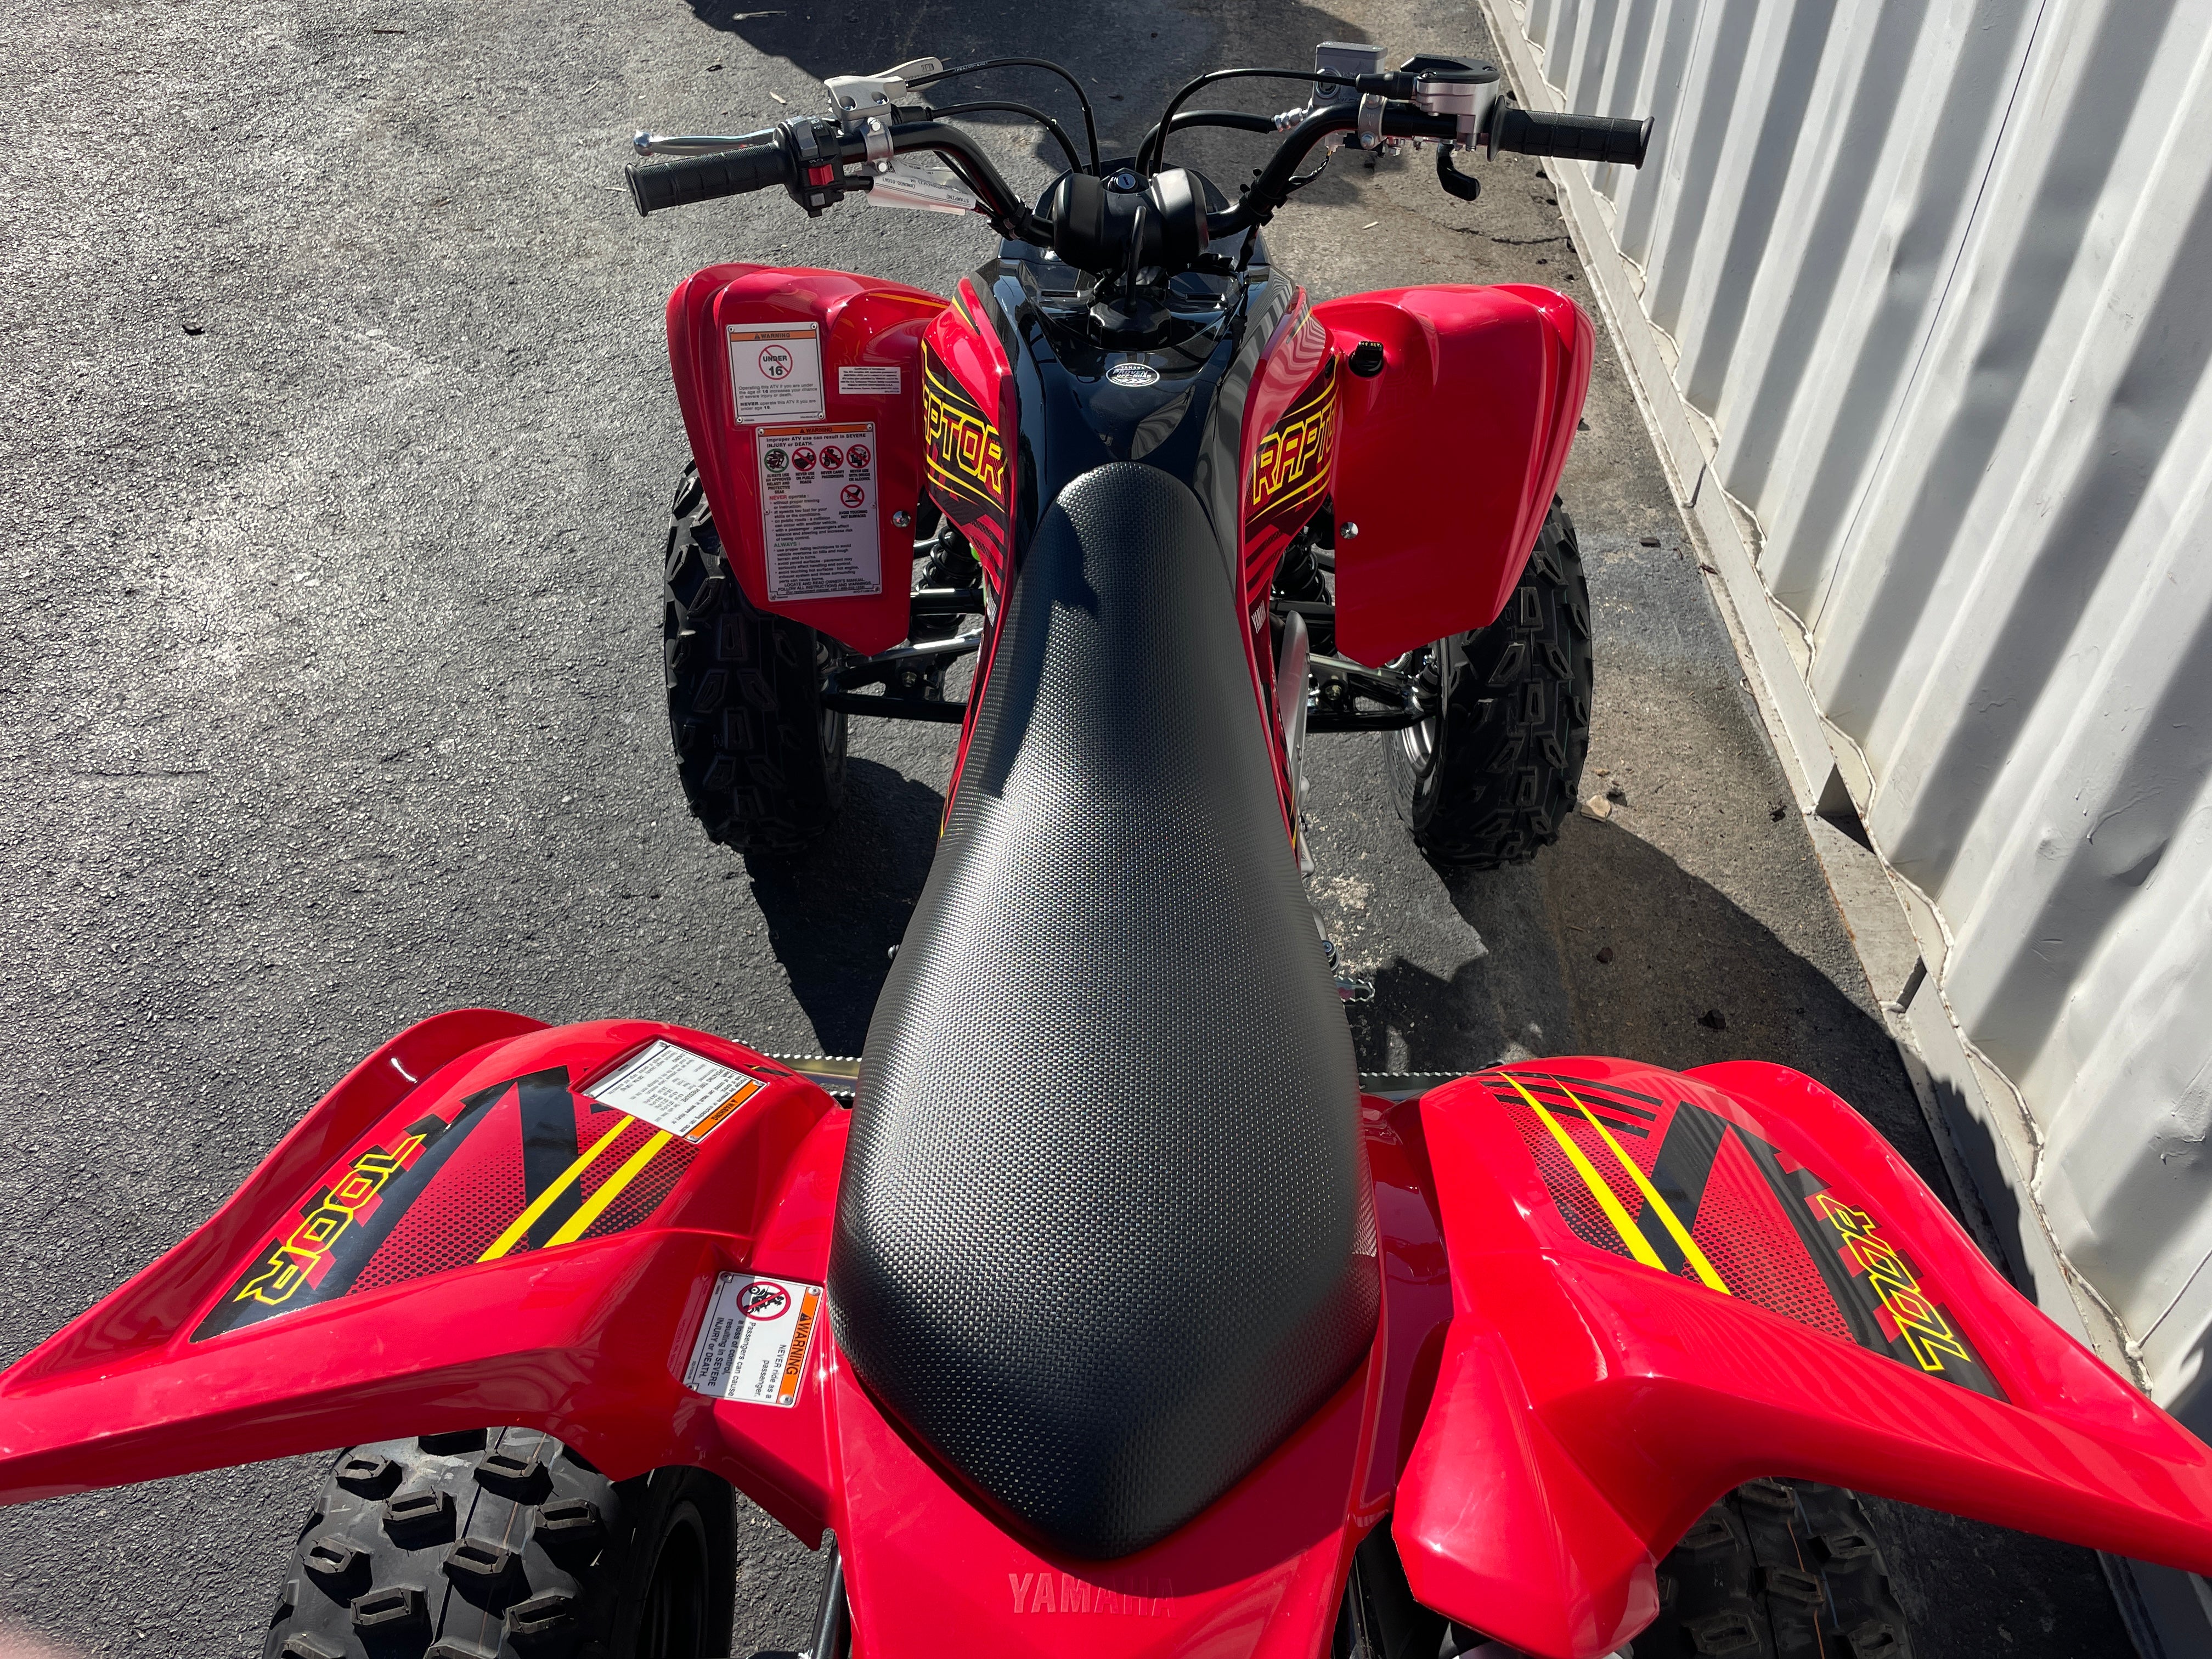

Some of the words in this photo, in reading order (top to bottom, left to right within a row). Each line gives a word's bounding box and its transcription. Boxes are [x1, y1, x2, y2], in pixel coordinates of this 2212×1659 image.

[946, 194, 969, 203] STAMPING
[769, 366, 783, 376] 16
[711, 1317, 724, 1342] INJURY
[719, 1318, 733, 1348] resulting
[733, 1325, 744, 1339] loss
[739, 1322, 756, 1360] Passengers
[774, 1344, 787, 1368] NEVER
[786, 1322, 811, 1375] WARNING
[698, 1352, 713, 1378] DEATH.
[708, 1357, 723, 1386] SEVERE
[770, 1370, 779, 1383] ride
[728, 1375, 738, 1396] cause
[768, 1384, 774, 1392] as
[1009, 1573, 1177, 1618] YAMAHA
